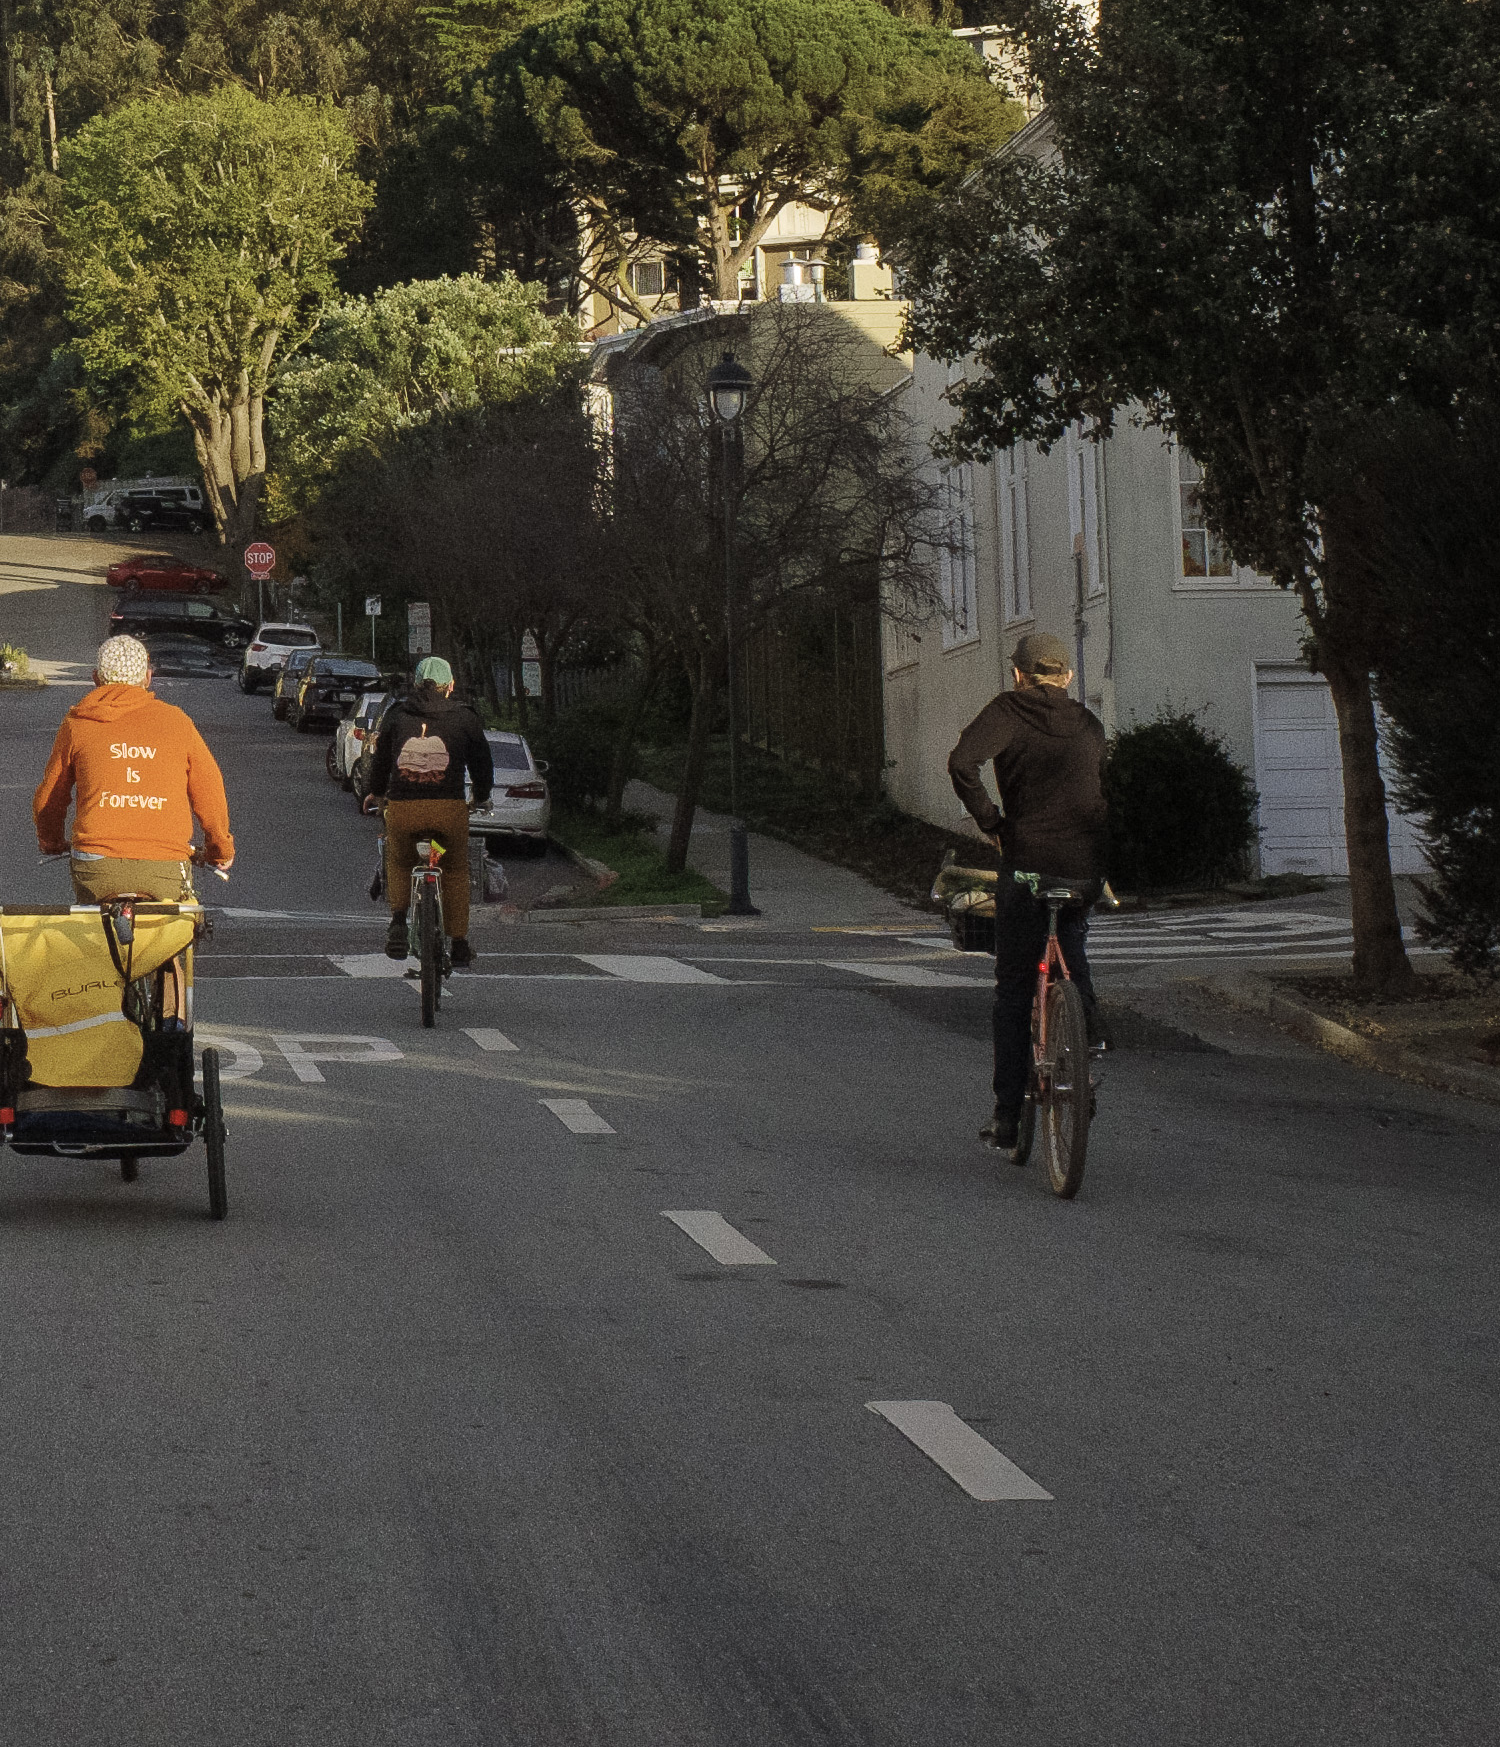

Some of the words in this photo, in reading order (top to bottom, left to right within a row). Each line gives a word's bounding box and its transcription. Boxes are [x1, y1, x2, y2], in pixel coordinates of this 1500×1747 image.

[247, 552, 273, 564] STOP
[109, 742, 157, 760] Slow
[99, 790, 168, 811] Forever
